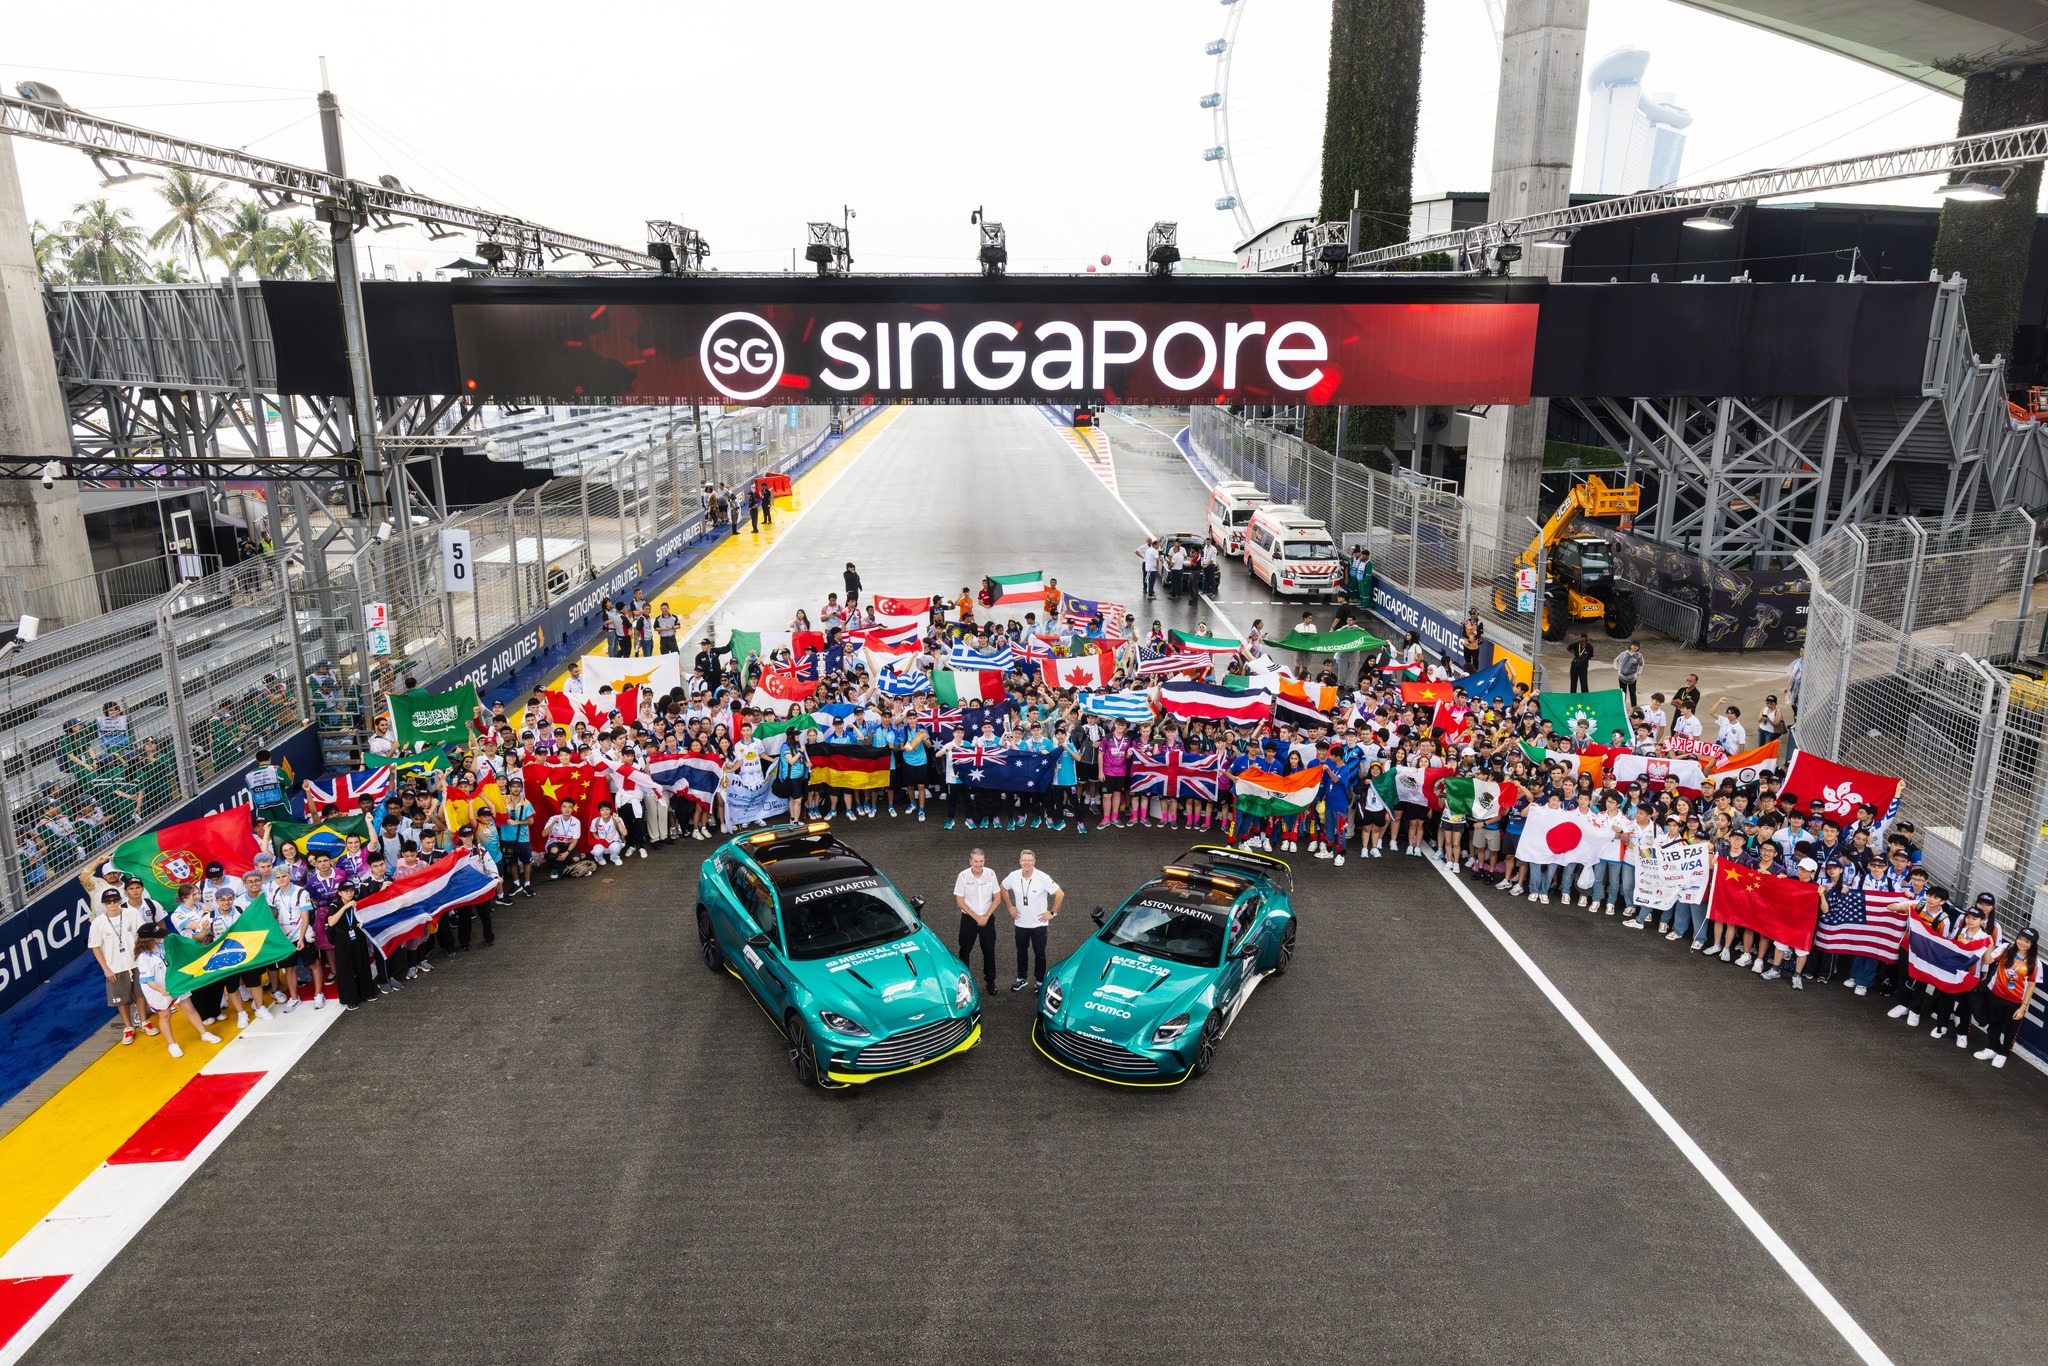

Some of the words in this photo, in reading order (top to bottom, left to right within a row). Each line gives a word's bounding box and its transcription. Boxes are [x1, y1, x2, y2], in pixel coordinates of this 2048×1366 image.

[712, 337, 774, 374] SG
[1556, 497, 1572, 520] JCB
[1680, 858, 1703, 871] VISA
[794, 888, 833, 904] ASTON
[835, 879, 878, 893] MARTIN
[1140, 899, 1174, 911] ASTON
[1173, 906, 1213, 922] MARTIN
[838, 946, 891, 964] MEDICAL
[891, 940, 917, 950] CAR
[852, 956, 874, 966] Drive
[873, 950, 899, 959] Safely
[1111, 955, 1149, 968] SAFETY
[1149, 965, 1171, 975] CAR
[1084, 1001, 1131, 1019] aramco
